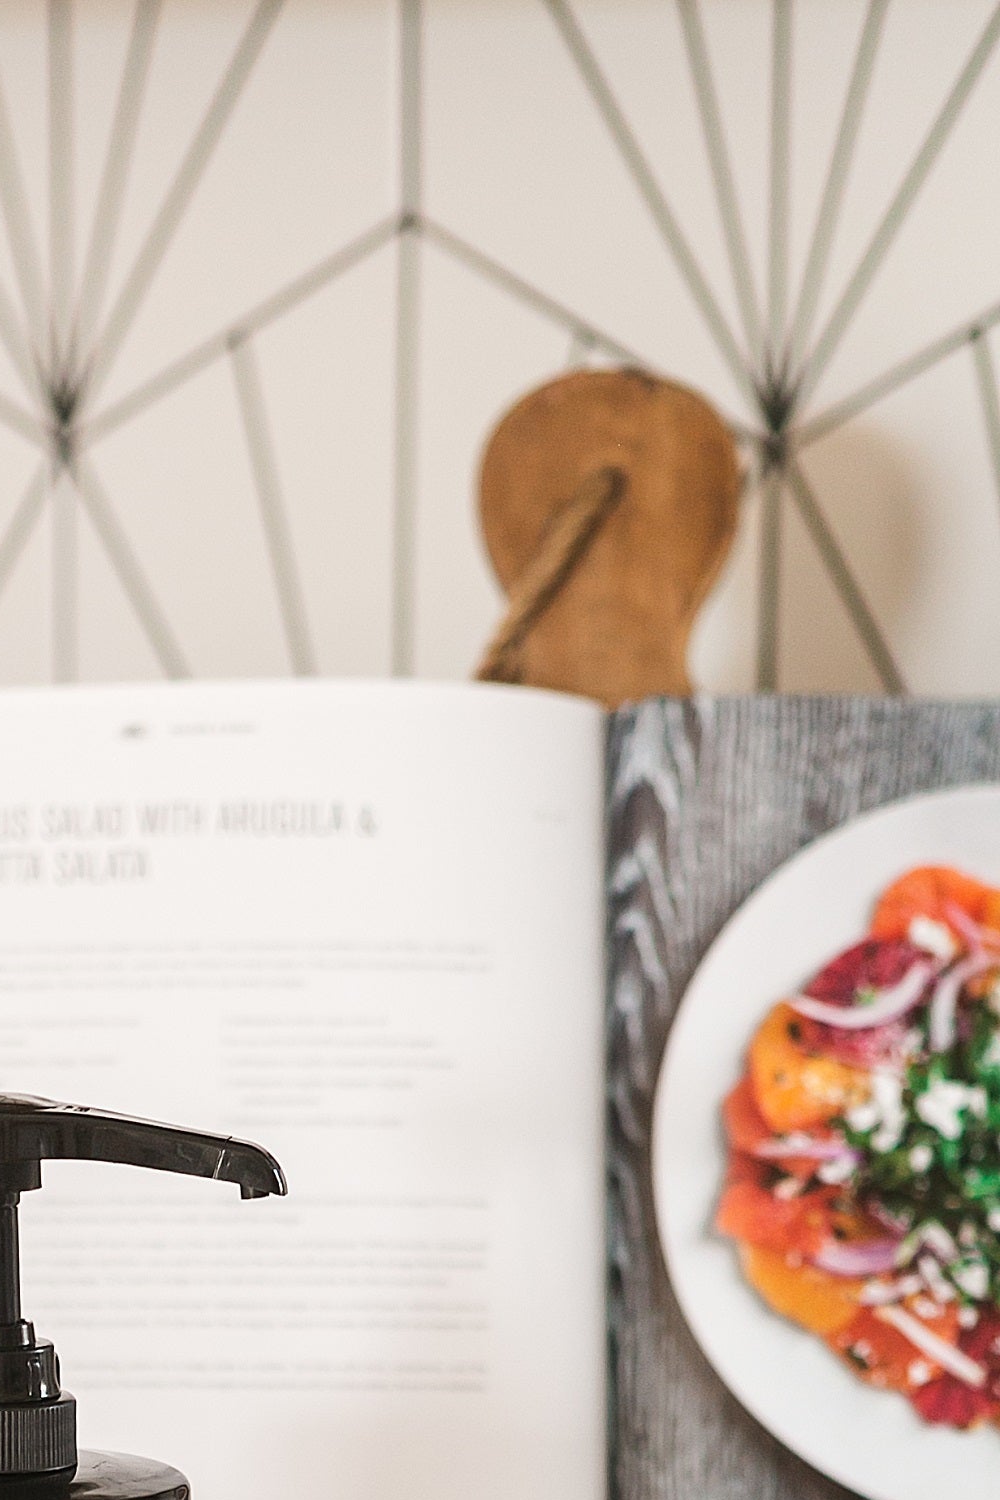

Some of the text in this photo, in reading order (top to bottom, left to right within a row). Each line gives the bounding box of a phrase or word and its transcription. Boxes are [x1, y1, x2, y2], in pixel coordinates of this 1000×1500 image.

[42, 804, 125, 841] SALAD
[139, 801, 204, 839] WITH
[216, 799, 347, 838] ARUGULA
[357, 802, 378, 838] &
[55, 848, 149, 885] SALATA
